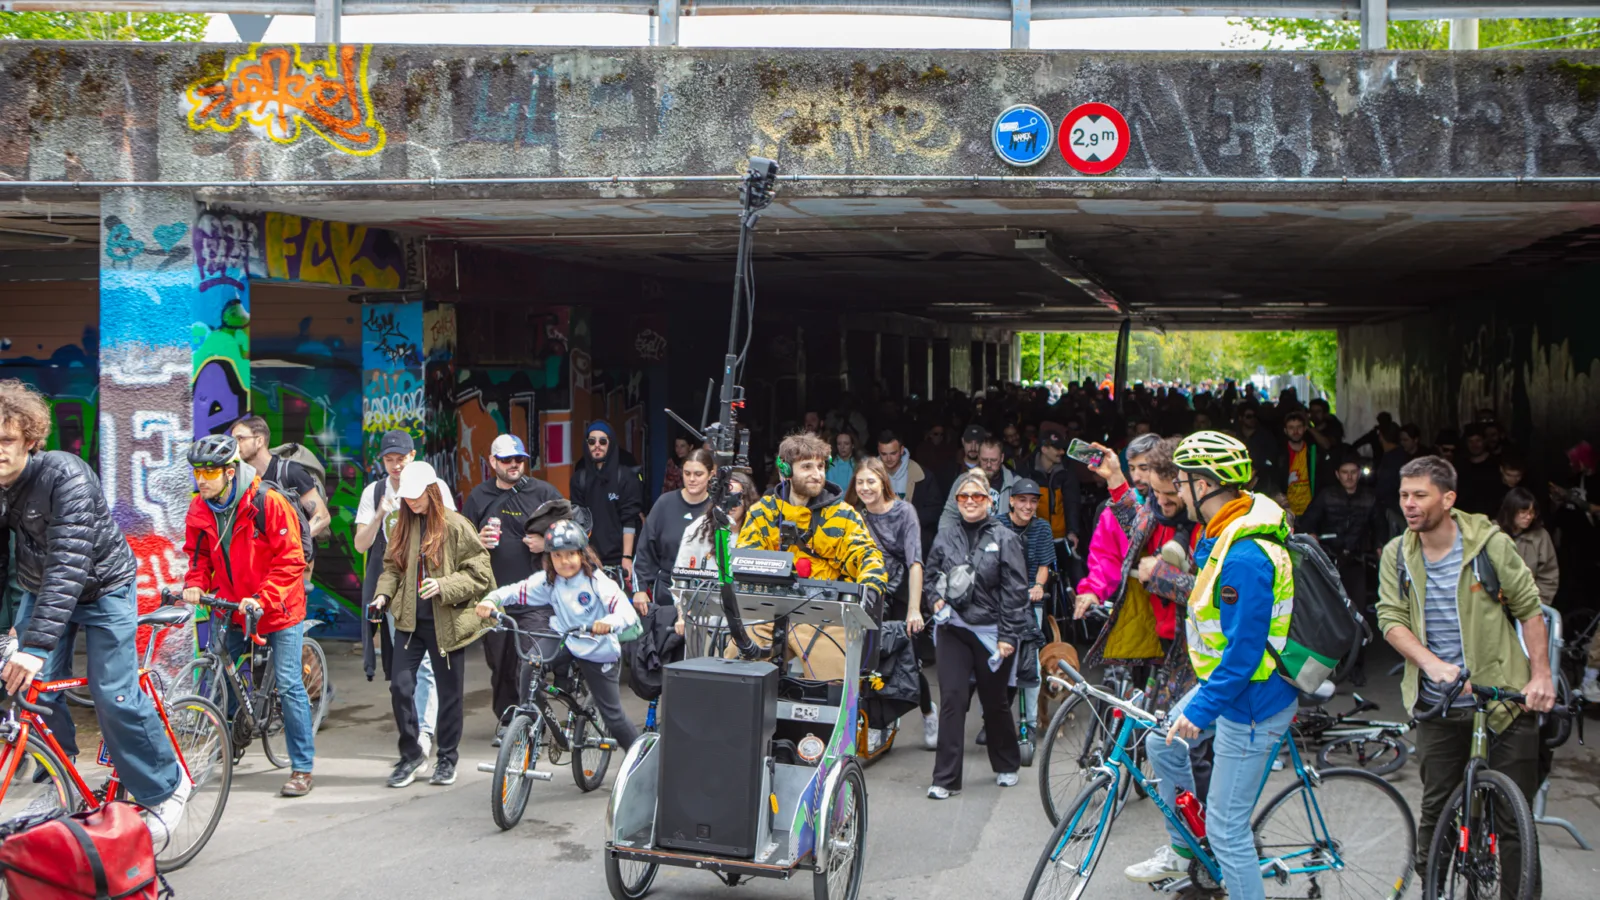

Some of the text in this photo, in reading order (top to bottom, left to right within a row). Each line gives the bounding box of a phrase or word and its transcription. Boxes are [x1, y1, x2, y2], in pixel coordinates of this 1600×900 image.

[1072, 128, 1115, 148] 2,9 m
[265, 211, 400, 290] FCK
[673, 568, 719, 578] @domwhiting
